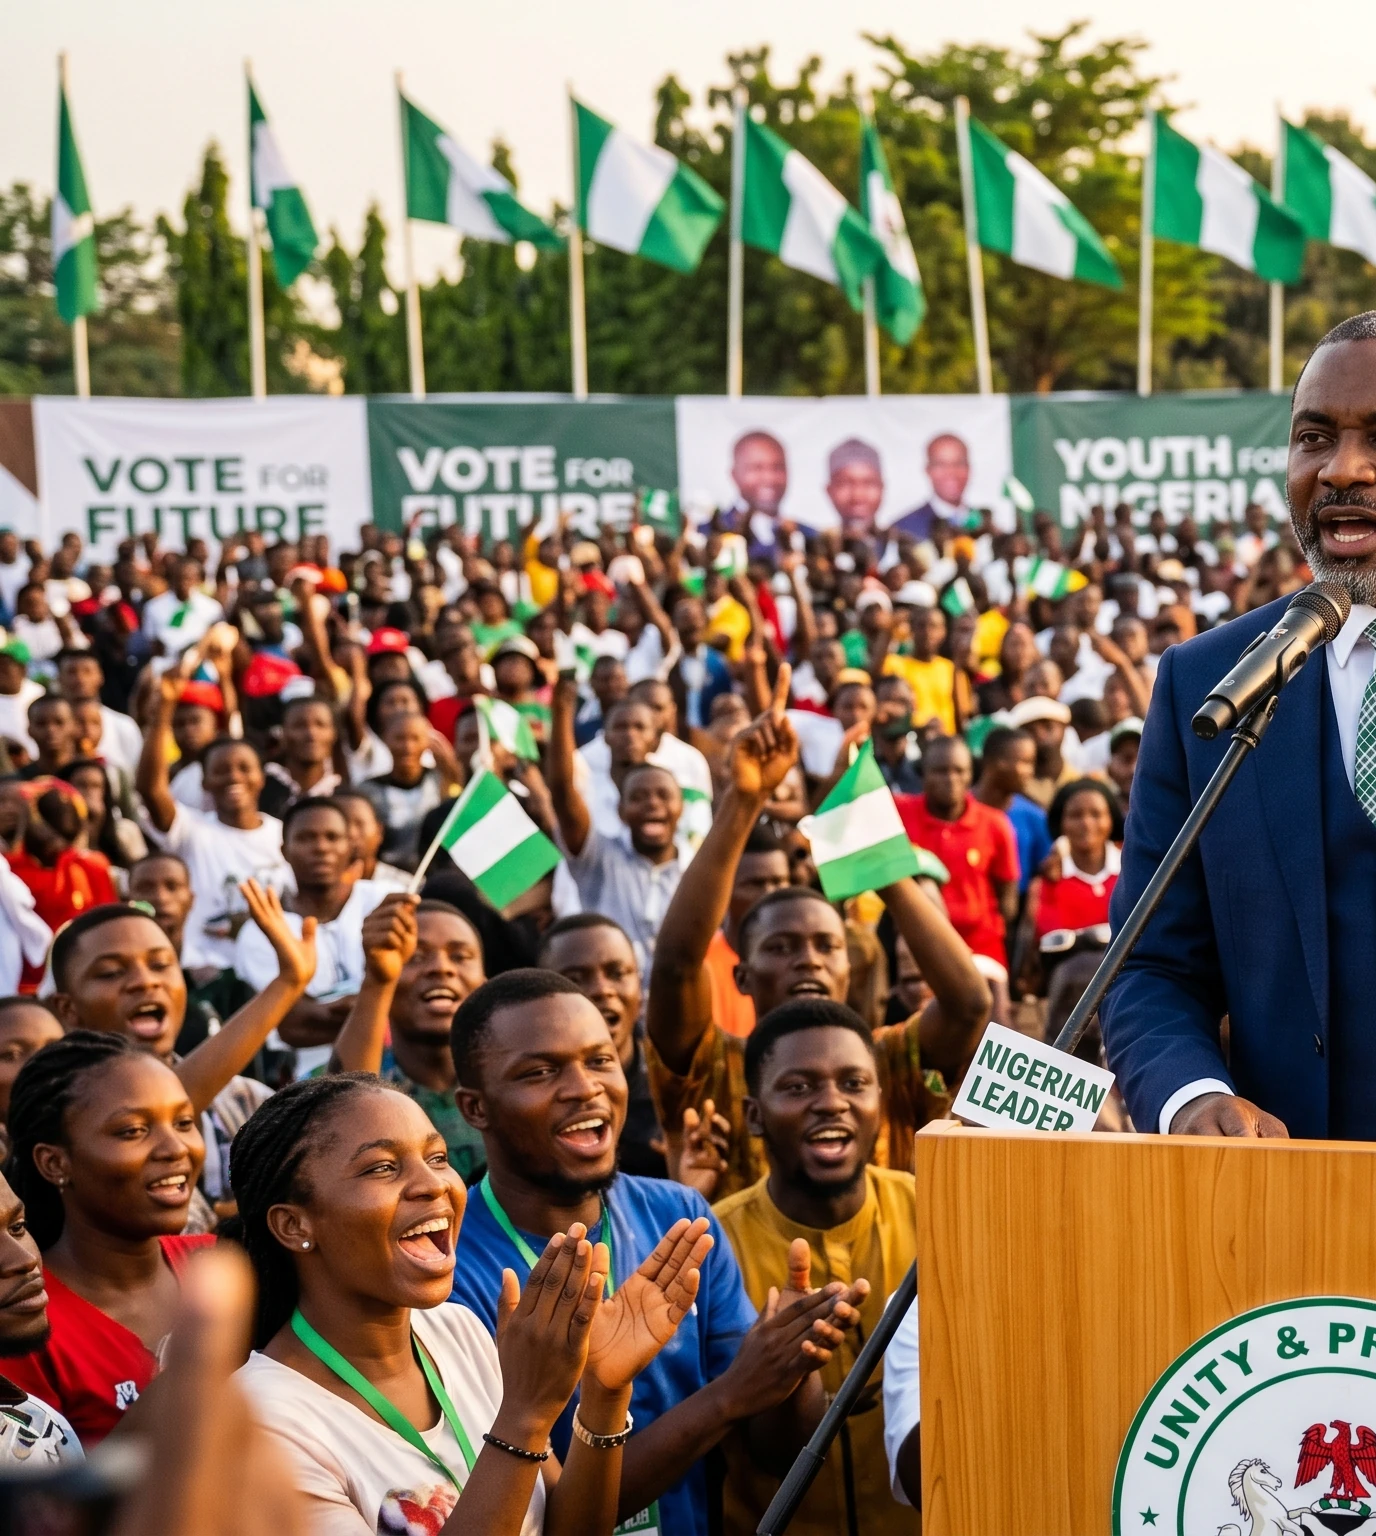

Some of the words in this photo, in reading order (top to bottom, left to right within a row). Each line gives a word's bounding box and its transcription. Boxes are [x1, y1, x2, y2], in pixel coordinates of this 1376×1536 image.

[84, 457, 243, 493] VOTE
[260, 464, 329, 493] FOR
[397, 445, 558, 492] VOTE
[564, 457, 634, 488] FOR
[1054, 435, 1232, 481] YOUTH
[977, 1039, 1106, 1114] NIGERIAN
[966, 1075, 1074, 1132] LEADER
[1143, 1339, 1255, 1470] UNITY
[1276, 1325, 1310, 1360] &
